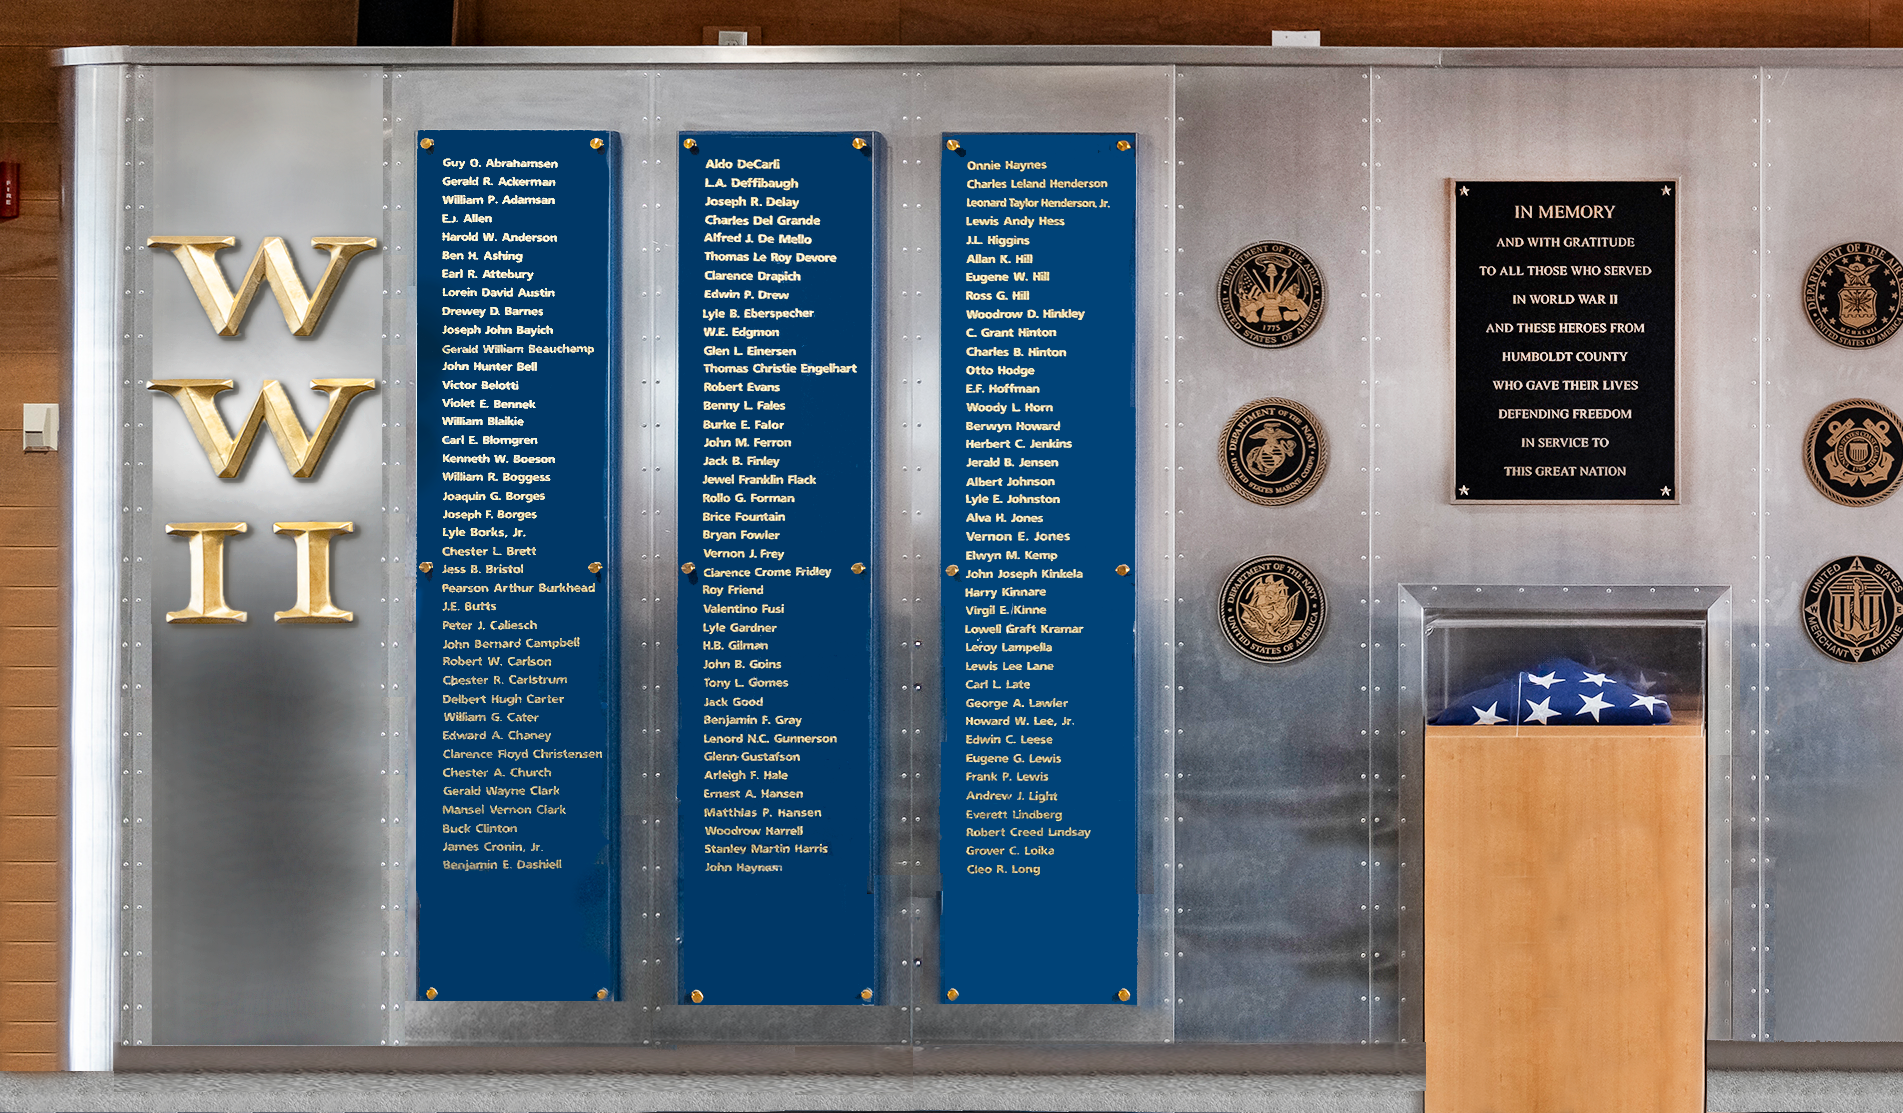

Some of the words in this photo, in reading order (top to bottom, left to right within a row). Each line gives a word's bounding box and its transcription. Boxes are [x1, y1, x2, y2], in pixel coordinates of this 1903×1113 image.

[442, 157, 466, 170] Guy
[469, 157, 482, 168] O.
[485, 157, 559, 169] Abrahamsen
[966, 160, 1002, 171] Onnie
[1005, 160, 1048, 173] Haynes
[1514, 205, 1533, 219] IN
[1538, 204, 1616, 219] MEMORY
[704, 214, 750, 226] Charles
[752, 214, 774, 226] Del
[776, 214, 821, 226] Grande
[441, 231, 479, 242] Harold
[482, 232, 498, 242] W.
[501, 231, 558, 243] Anderson
[1496, 237, 1525, 248] AND
[1526, 236, 1561, 248] WITH
[1562, 236, 1636, 248] GRATITUDE
[1223, 245, 1268, 286] DEPARTMENT
[1272, 245, 1285, 253] OF
[1288, 249, 1305, 263] THE
[1304, 264, 1320, 286] ARMY
[1478, 265, 1497, 277] TO
[1499, 265, 1525, 276] ALL
[1526, 265, 1568, 277] THOSE
[1570, 265, 1602, 277] WHO
[1603, 265, 1653, 276] SERVED
[704, 269, 754, 281] Clarence
[757, 270, 802, 284] Drapich
[1806, 247, 1843, 310] DEPARTMENT
[1847, 244, 1860, 252] OF
[1865, 244, 1886, 259] THE
[1886, 258, 1902, 275] AIR
[146, 235, 378, 336] W
[1512, 294, 1527, 305] IN
[1528, 293, 1576, 305] WORLD
[1577, 293, 1607, 305] WAR
[1609, 293, 1619, 305] II
[965, 308, 1024, 320] Woodrow
[1026, 309, 1040, 319] D.
[1042, 308, 1086, 321] Hinkley
[1222, 298, 1241, 330] UNITED
[1243, 330, 1277, 343] STATES
[1282, 332, 1293, 342] OF
[1297, 299, 1320, 334] AMERICA
[1485, 322, 1515, 334] AND
[1516, 322, 1557, 334] THESE
[1558, 322, 1608, 334] HEROES
[1609, 322, 1645, 334] FROM
[1501, 351, 1574, 363] HUMBOLDT
[1575, 351, 1629, 363] COUNTY
[1492, 379, 1524, 391] WHO
[1525, 380, 1560, 391] GAVE
[1561, 379, 1600, 391] THEIR
[1602, 379, 1639, 391] LIVES
[1498, 408, 1570, 420] DEFENDING
[1572, 408, 1632, 420] FREEDOM
[146, 378, 376, 478] W
[1521, 437, 1535, 448] IN
[1537, 437, 1590, 448] SERVICE
[1591, 437, 1610, 448] TO
[1503, 466, 1533, 477] THIS
[1534, 466, 1578, 477] GREAT
[1579, 465, 1627, 477] NATION
[1811, 563, 1841, 594] UNITED
[1874, 563, 1903, 593] STATES
[1808, 616, 1849, 658] MERCHANT
[1871, 624, 1903, 656] MARINE
[703, 696, 729, 707] Jack
[732, 696, 764, 707] Good
[965, 734, 1002, 745] Edwin
[1005, 734, 1017, 745] C.
[1020, 734, 1054, 745] Leese
[703, 769, 747, 783] Arleigh
[749, 770, 760, 780] F.
[763, 769, 789, 781] Hale
[442, 823, 472, 834] Buck
[475, 823, 518, 834] Clinton
